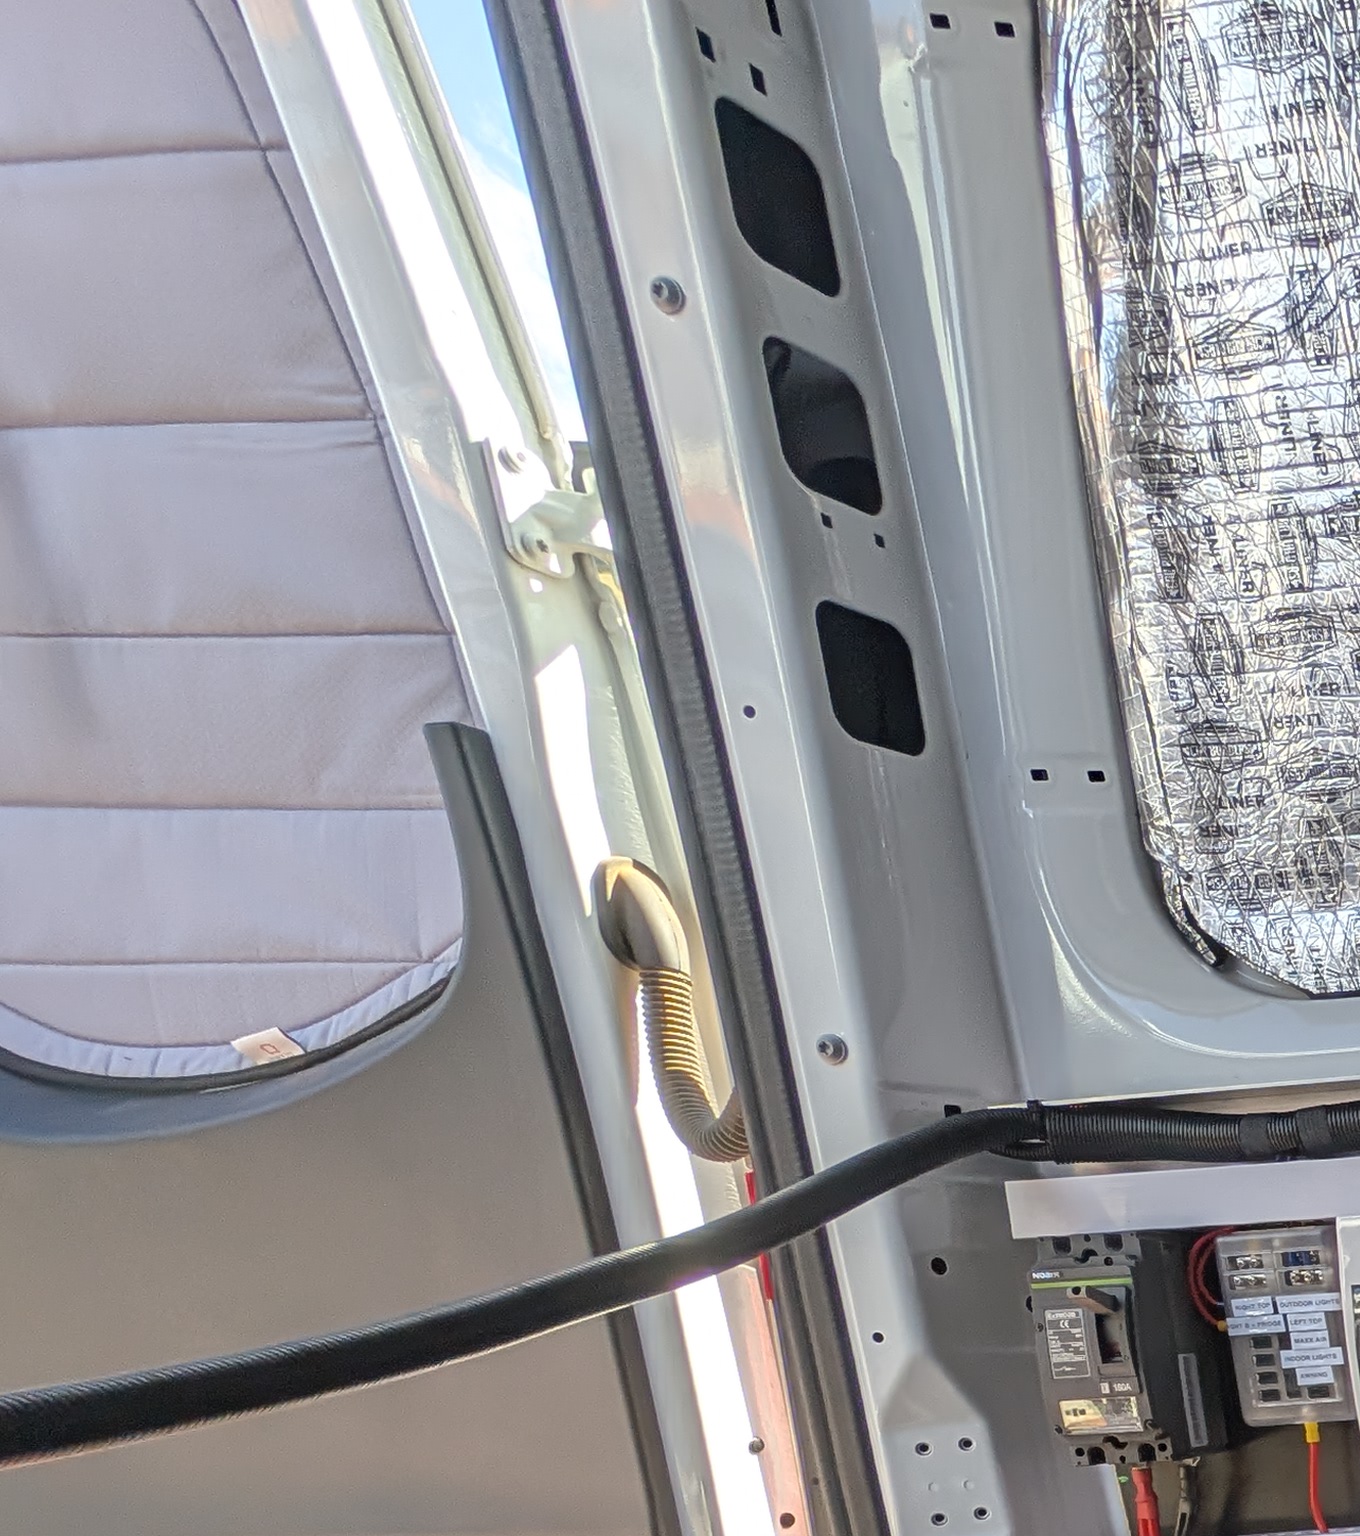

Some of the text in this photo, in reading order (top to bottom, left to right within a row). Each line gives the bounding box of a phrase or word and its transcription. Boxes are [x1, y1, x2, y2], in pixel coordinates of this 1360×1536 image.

[1280, 1300, 1313, 1308] OUTDOOR
[1290, 1317, 1322, 1326] LEFT TOP
[1284, 1354, 1310, 1362] INDOOR
